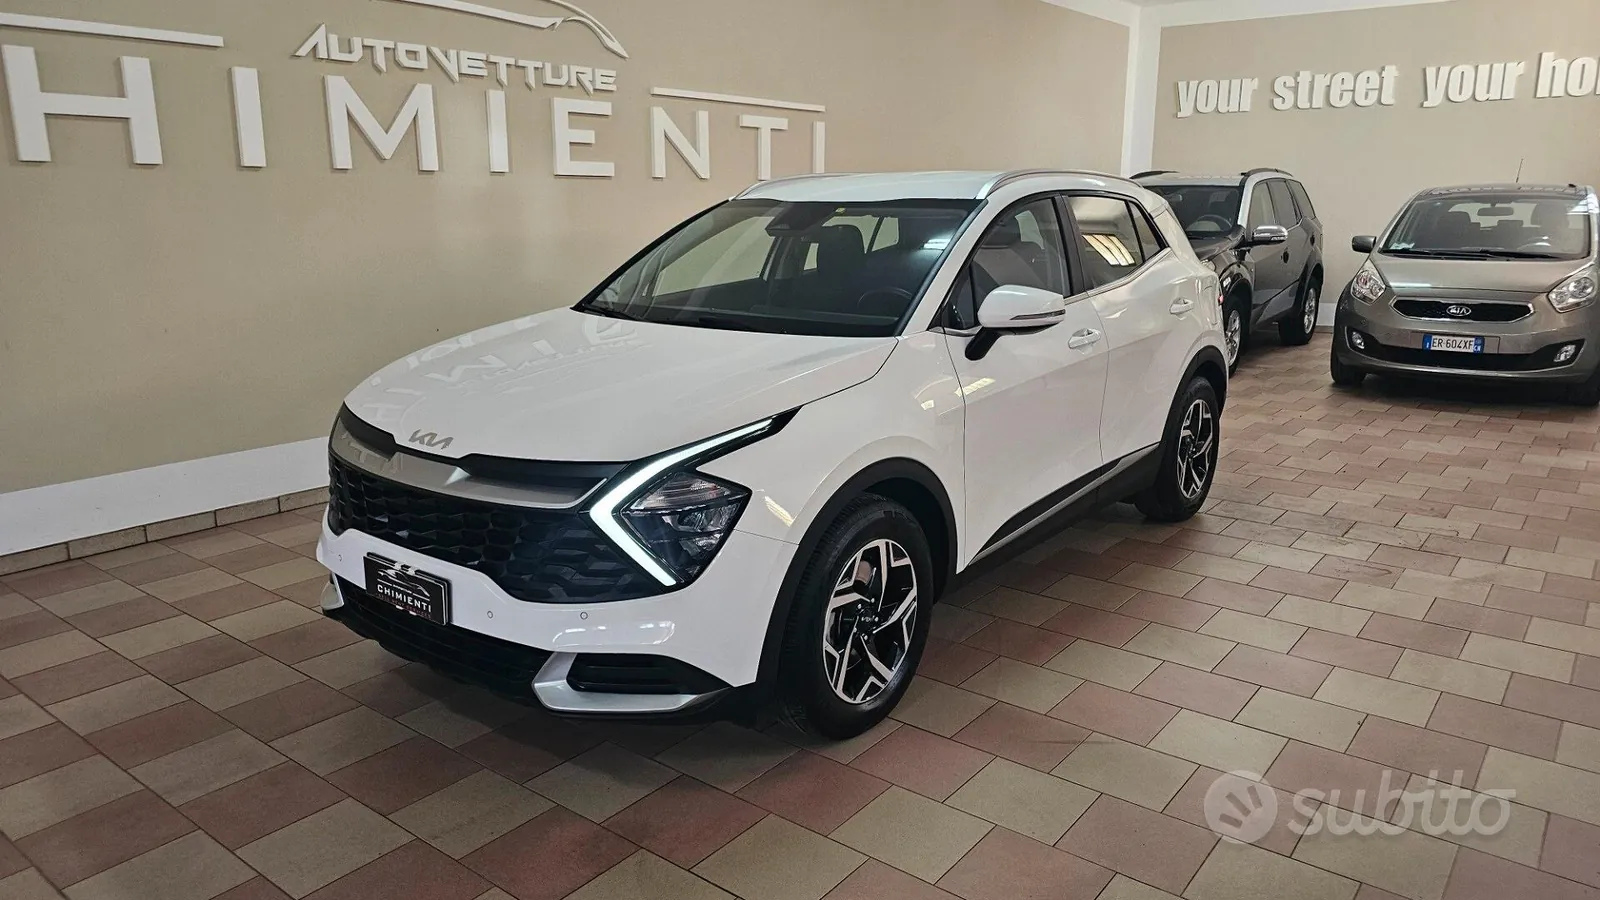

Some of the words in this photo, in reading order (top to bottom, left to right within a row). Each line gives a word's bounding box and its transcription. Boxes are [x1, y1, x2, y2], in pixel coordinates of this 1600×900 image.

[293, 22, 617, 96] AUTOVETTURE
[1176, 77, 1258, 118] your
[1272, 65, 1399, 111] street
[1422, 60, 1526, 108] your
[1534, 51, 1600, 99] ho
[377, 584, 431, 612] CHIMIENTI
